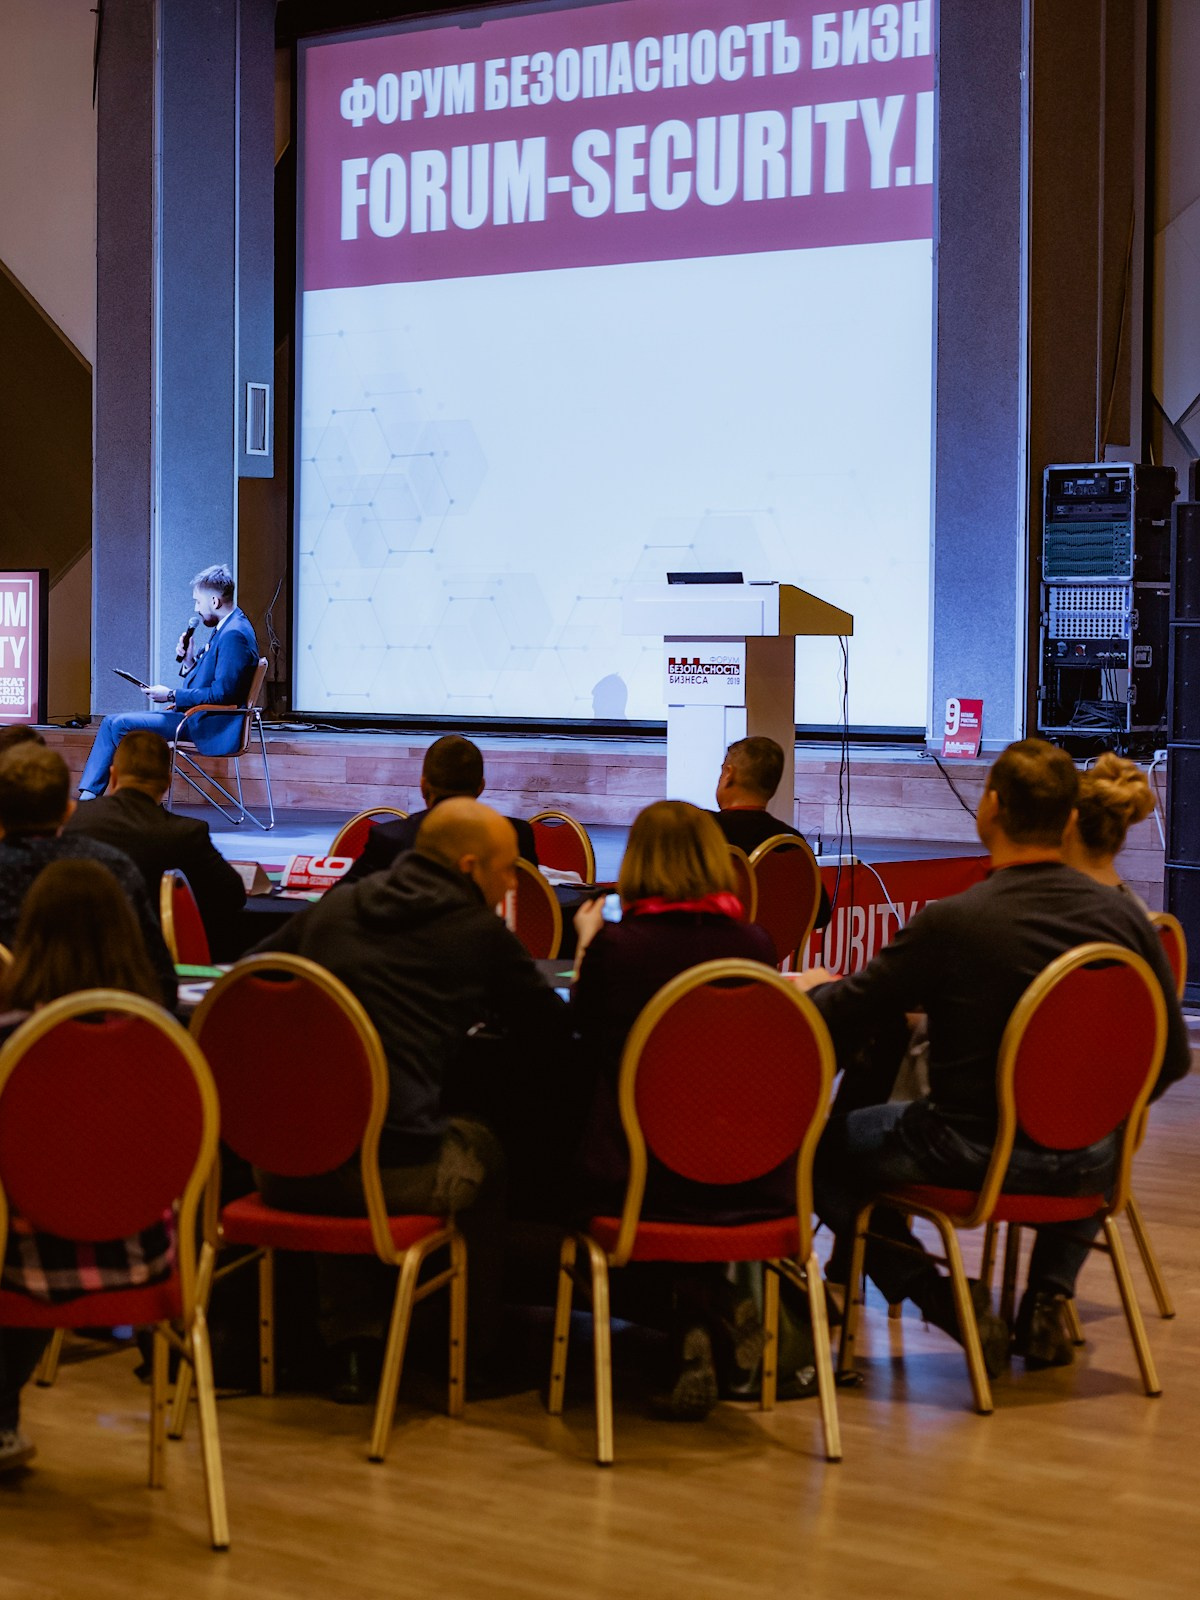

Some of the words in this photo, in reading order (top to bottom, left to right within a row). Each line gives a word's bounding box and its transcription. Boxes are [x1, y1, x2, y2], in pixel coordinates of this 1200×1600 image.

[340, 62, 476, 128] ФОРУМ
[484, 19, 800, 111] БЕЗОПАСНОСТЬ
[811, 0, 931, 70] БИЗН
[709, 655, 740, 664] ФОРУМ
[668, 664, 740, 675] БЕЗОПАСНОСТЬ
[669, 675, 708, 685] БИЗНЕСА
[726, 677, 740, 685] 2019
